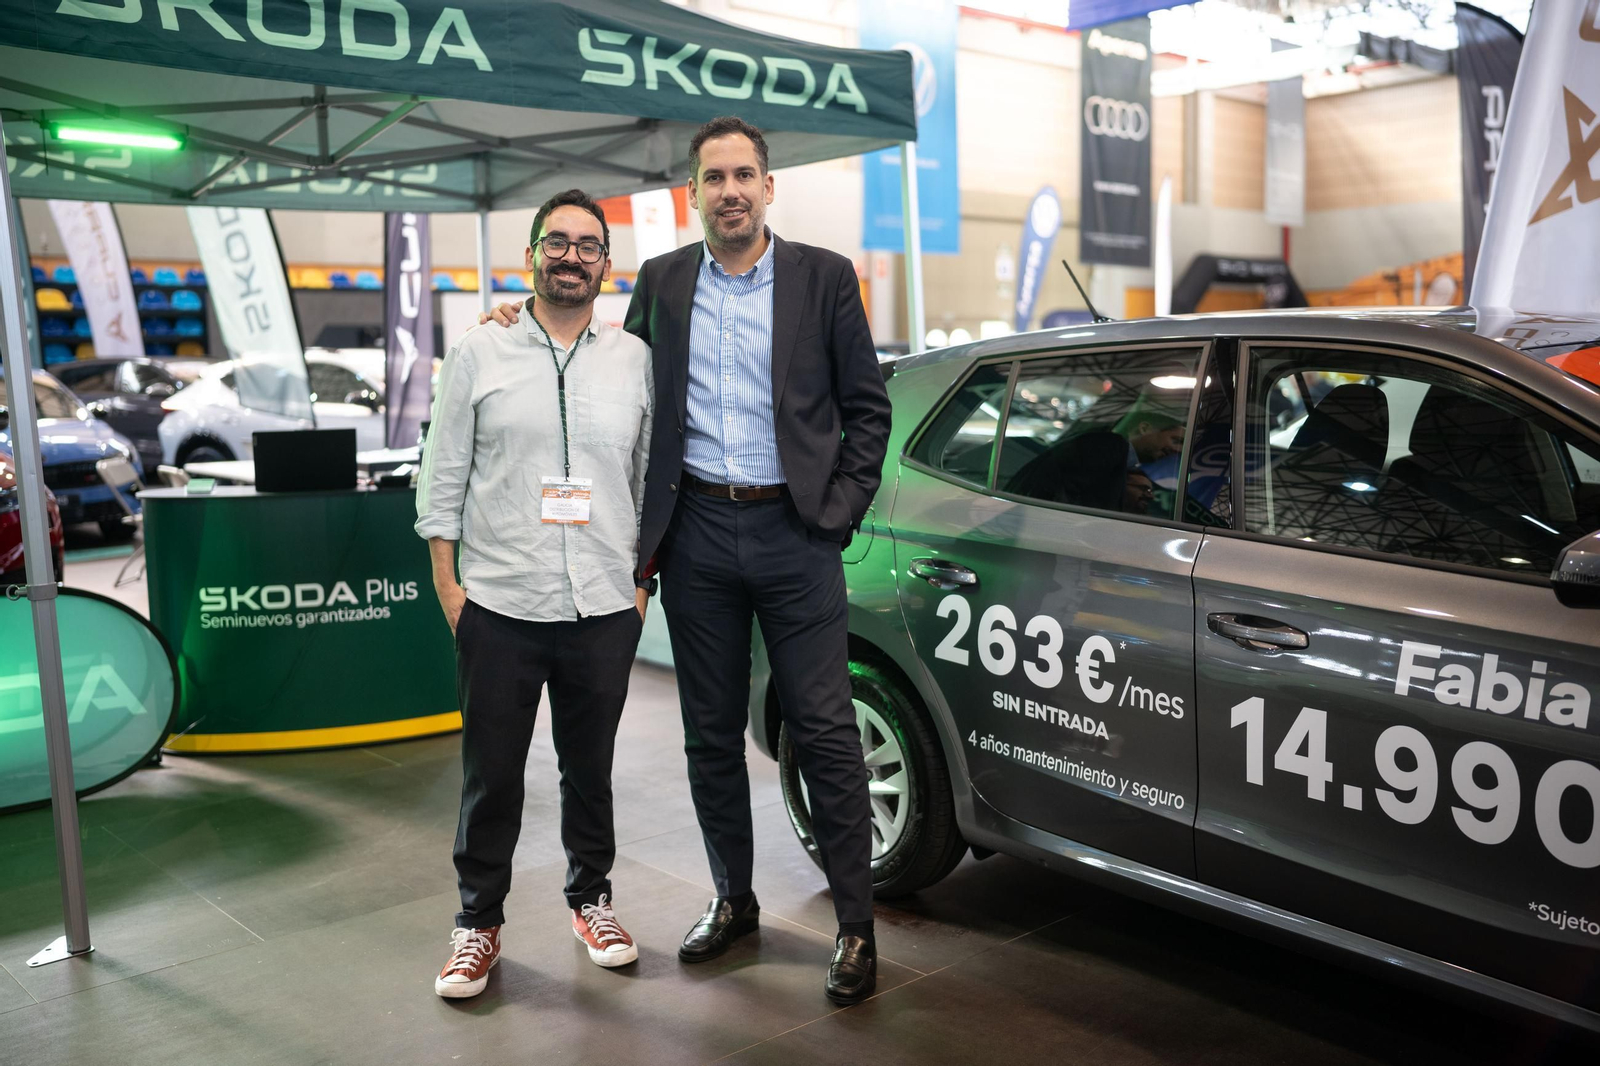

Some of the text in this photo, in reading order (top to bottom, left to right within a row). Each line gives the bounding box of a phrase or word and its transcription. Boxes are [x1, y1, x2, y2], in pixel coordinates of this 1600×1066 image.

[578, 27, 868, 114] SKODA
[199, 577, 419, 612] SKODA Plus
[200, 605, 391, 629] Seminuevos garantizados
[934, 594, 1064, 689] 263
[992, 690, 1110, 741] SIN ENTRADA
[1394, 639, 1592, 729] Fabia
[967, 729, 1185, 810] 4 años mantenimiento y seguro
[1230, 696, 1600, 869] 14.990
